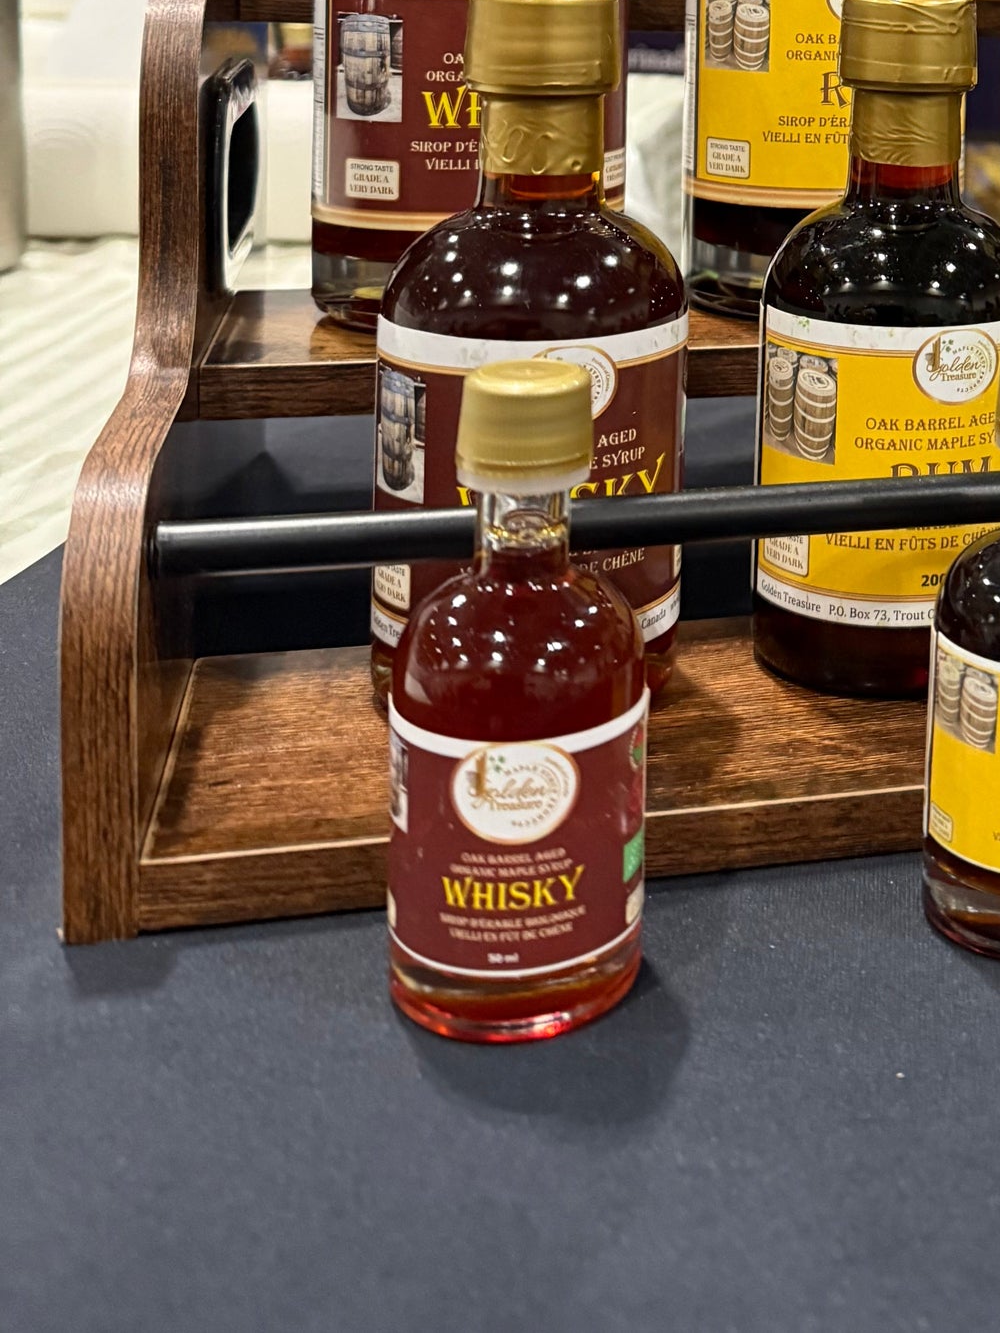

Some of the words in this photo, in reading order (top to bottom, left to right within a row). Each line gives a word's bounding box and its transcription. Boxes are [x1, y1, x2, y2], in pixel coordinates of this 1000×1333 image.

[795, 33, 824, 45] OAK
[777, 116, 816, 128] SIROP
[762, 131, 802, 144] VIELLI
[804, 132, 821, 145] EN
[410, 140, 452, 153] SIROP
[425, 158, 472, 171] VIELLI
[724, 162, 746, 175] DARK
[353, 174, 382, 185] GRADE
[349, 183, 372, 195] VERY
[371, 184, 395, 196] DARK
[940, 371, 977, 382] Treasure
[865, 417, 900, 432] OAK
[904, 416, 965, 432] BARREL
[967, 411, 996, 428] AGE
[596, 428, 637, 449] AGED
[854, 436, 924, 452] ORGANIC
[926, 434, 977, 451] MAPLE
[601, 445, 646, 468] SYRUP
[825, 533, 872, 551] VIELLI
[874, 537, 896, 551] EN
[898, 534, 938, 552] FÛTS
[939, 534, 960, 550] DE
[602, 547, 645, 573] CHÊNE
[761, 579, 783, 601] Golden
[782, 588, 822, 614] Treasure
[828, 603, 848, 618] P.O.
[849, 607, 871, 621] Box
[873, 609, 891, 623] 73,
[892, 608, 925, 622] Trout
[641, 608, 667, 630] Canada
[442, 864, 586, 911] WHISKY
